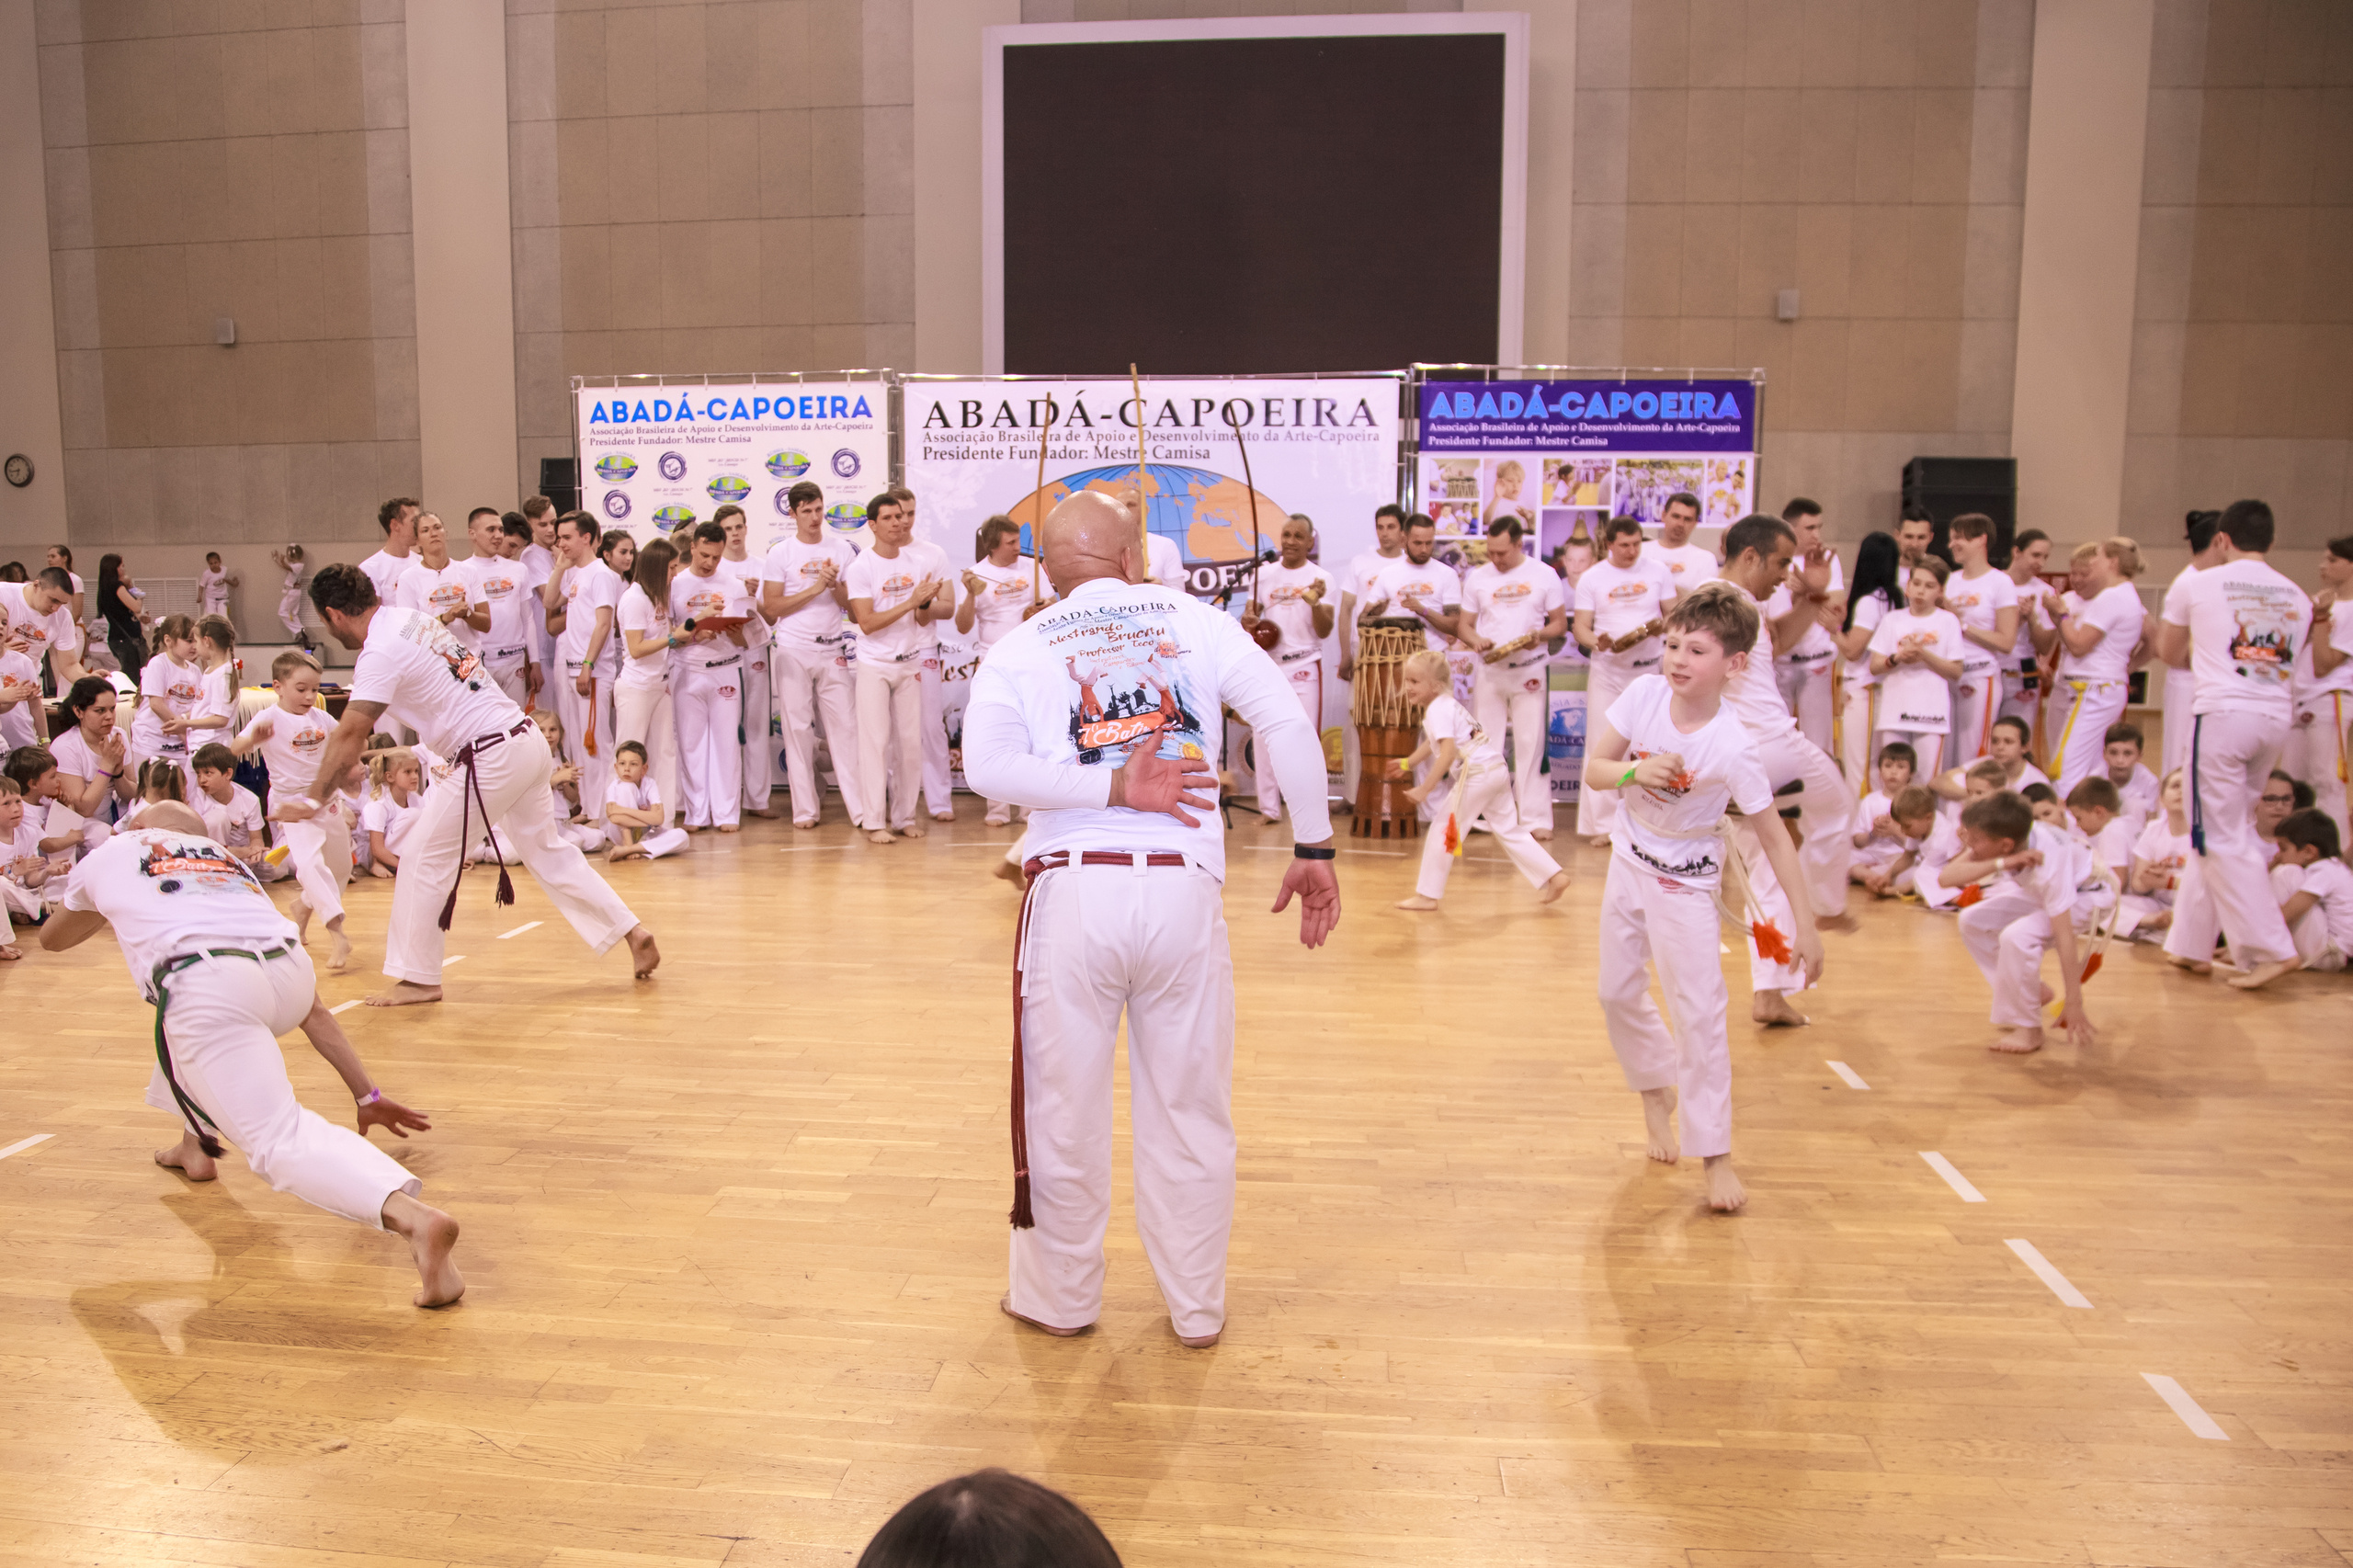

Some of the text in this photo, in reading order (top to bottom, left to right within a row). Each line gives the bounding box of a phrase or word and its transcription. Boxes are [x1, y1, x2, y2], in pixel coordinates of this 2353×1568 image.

[589, 392, 873, 424] ABADÁ-CAPOEIRA
[922, 390, 1380, 428] ABADÁ-CAPOEIRA
[1428, 384, 1742, 419] ABADÁ-CAPOEIRA
[589, 426, 634, 437] Associação
[636, 425, 676, 434] Brasileira
[677, 425, 688, 434] de
[690, 425, 716, 436] Apoio
[724, 423, 799, 433] Desenvolvimento
[801, 423, 812, 431] da
[813, 421, 873, 433] Arte-Capoeira
[1429, 423, 1479, 433] Associação
[1481, 422, 1526, 432] Brasileira
[1528, 422, 1539, 432] de
[1541, 422, 1570, 434] Apoio
[1578, 422, 1660, 432] Desenvolvimento
[1662, 422, 1674, 432] da
[1676, 422, 1740, 434] Arte-Capoeira
[589, 434, 752, 447] Presidente Fundador: Mestre Camisa
[923, 430, 994, 444] Associação
[998, 430, 1061, 442] Brasilera
[1065, 430, 1080, 442] de
[1085, 430, 1126, 444] Apoio
[1130, 433, 1137, 442] e
[1264, 429, 1279, 441] da
[1284, 428, 1380, 445] Arte-Capoeira
[1428, 436, 1608, 446] Presidente Fundador: Mestre Camisa
[923, 445, 1004, 460] Presidente
[1152, 444, 1211, 459] Camisa
[1049, 622, 1123, 646] Mestrando
[1077, 644, 1125, 657] Professor
